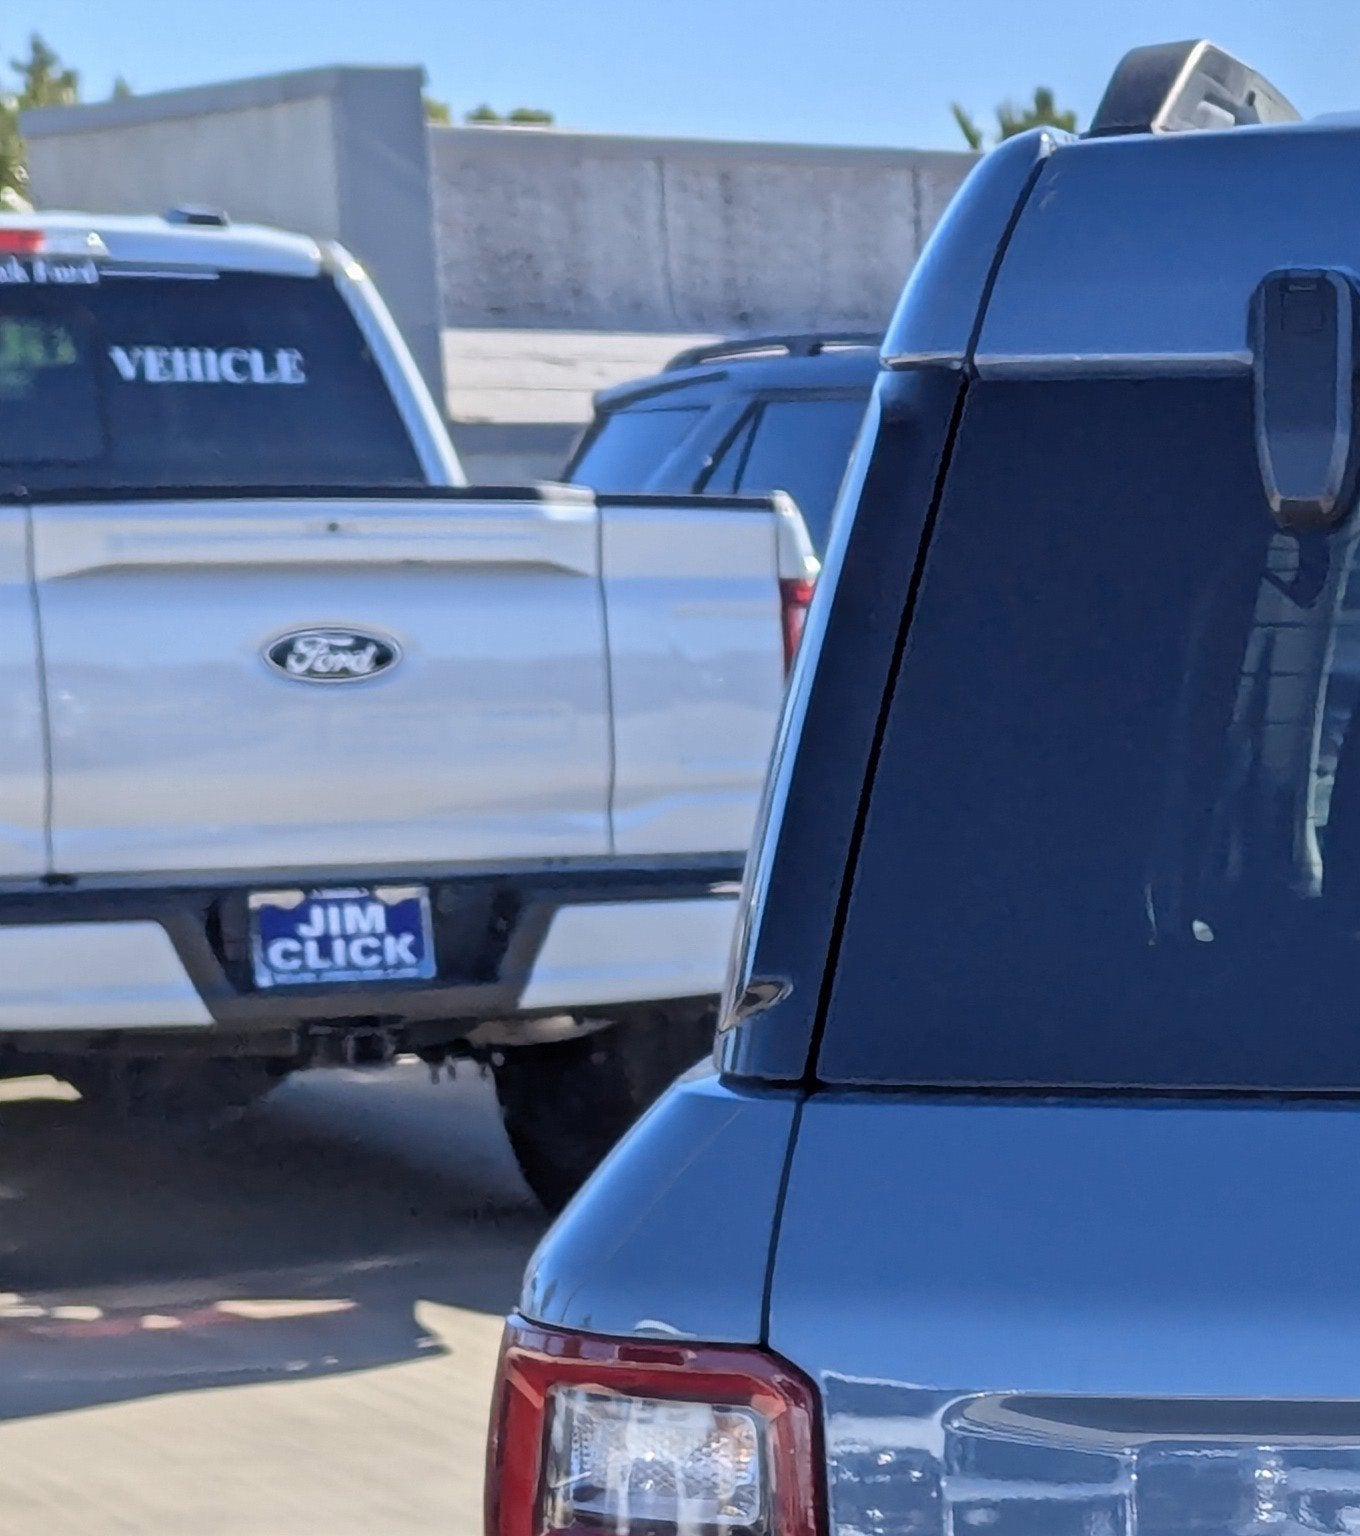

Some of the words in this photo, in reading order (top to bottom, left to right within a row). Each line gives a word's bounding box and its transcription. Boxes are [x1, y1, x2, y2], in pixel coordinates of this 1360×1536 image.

[109, 346, 306, 384] VEHICLE
[286, 636, 377, 674] Ford
[297, 904, 387, 937] JIM
[268, 934, 418, 970] CLICK
